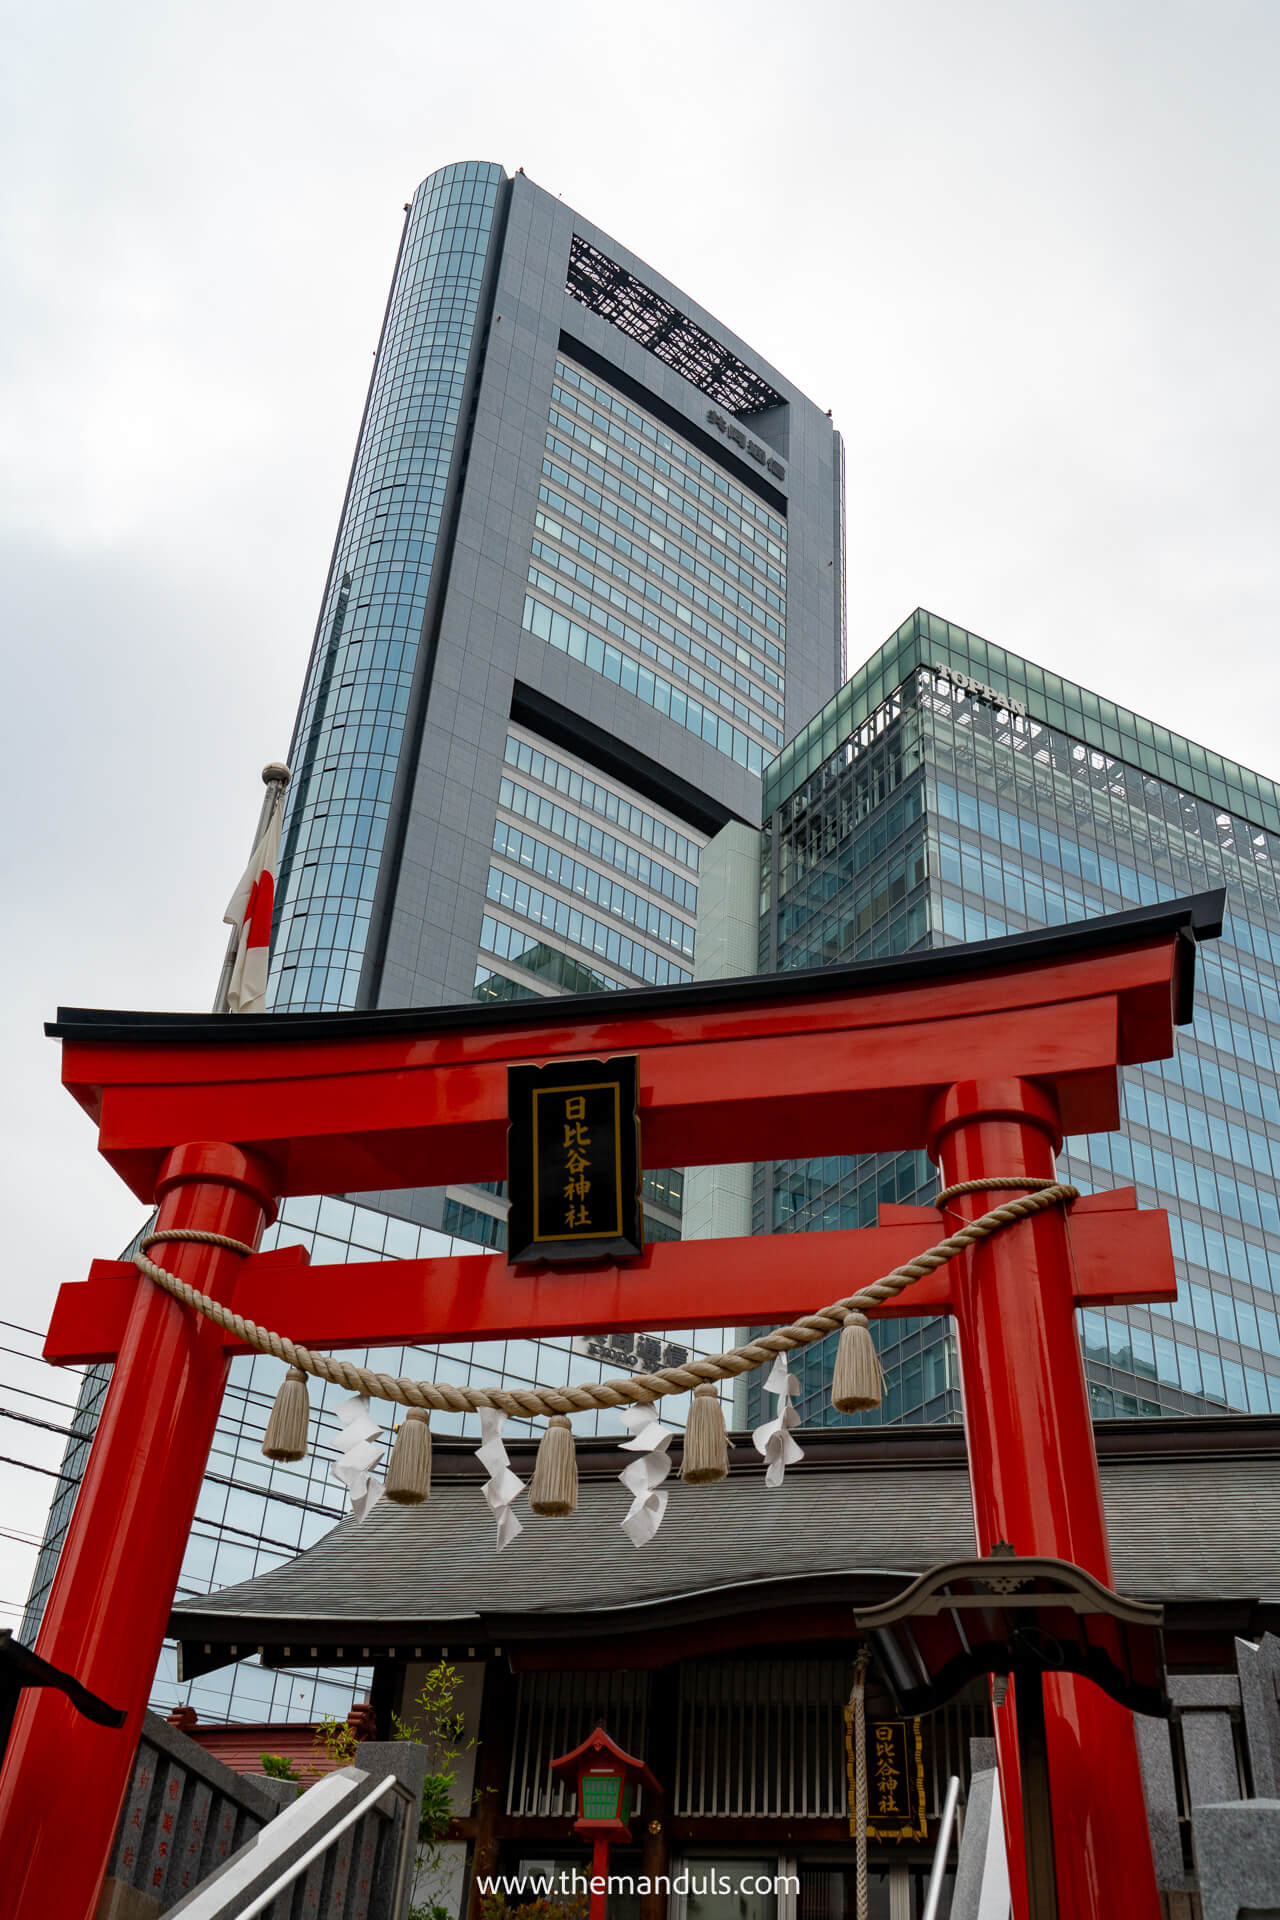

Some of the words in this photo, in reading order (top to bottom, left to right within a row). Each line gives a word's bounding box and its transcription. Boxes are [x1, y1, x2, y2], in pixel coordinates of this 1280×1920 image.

[935, 661, 1027, 717] TOPPAN
[562, 1096, 593, 1230] 日比谷神社
[873, 1726, 901, 1814] 日比谷神社
